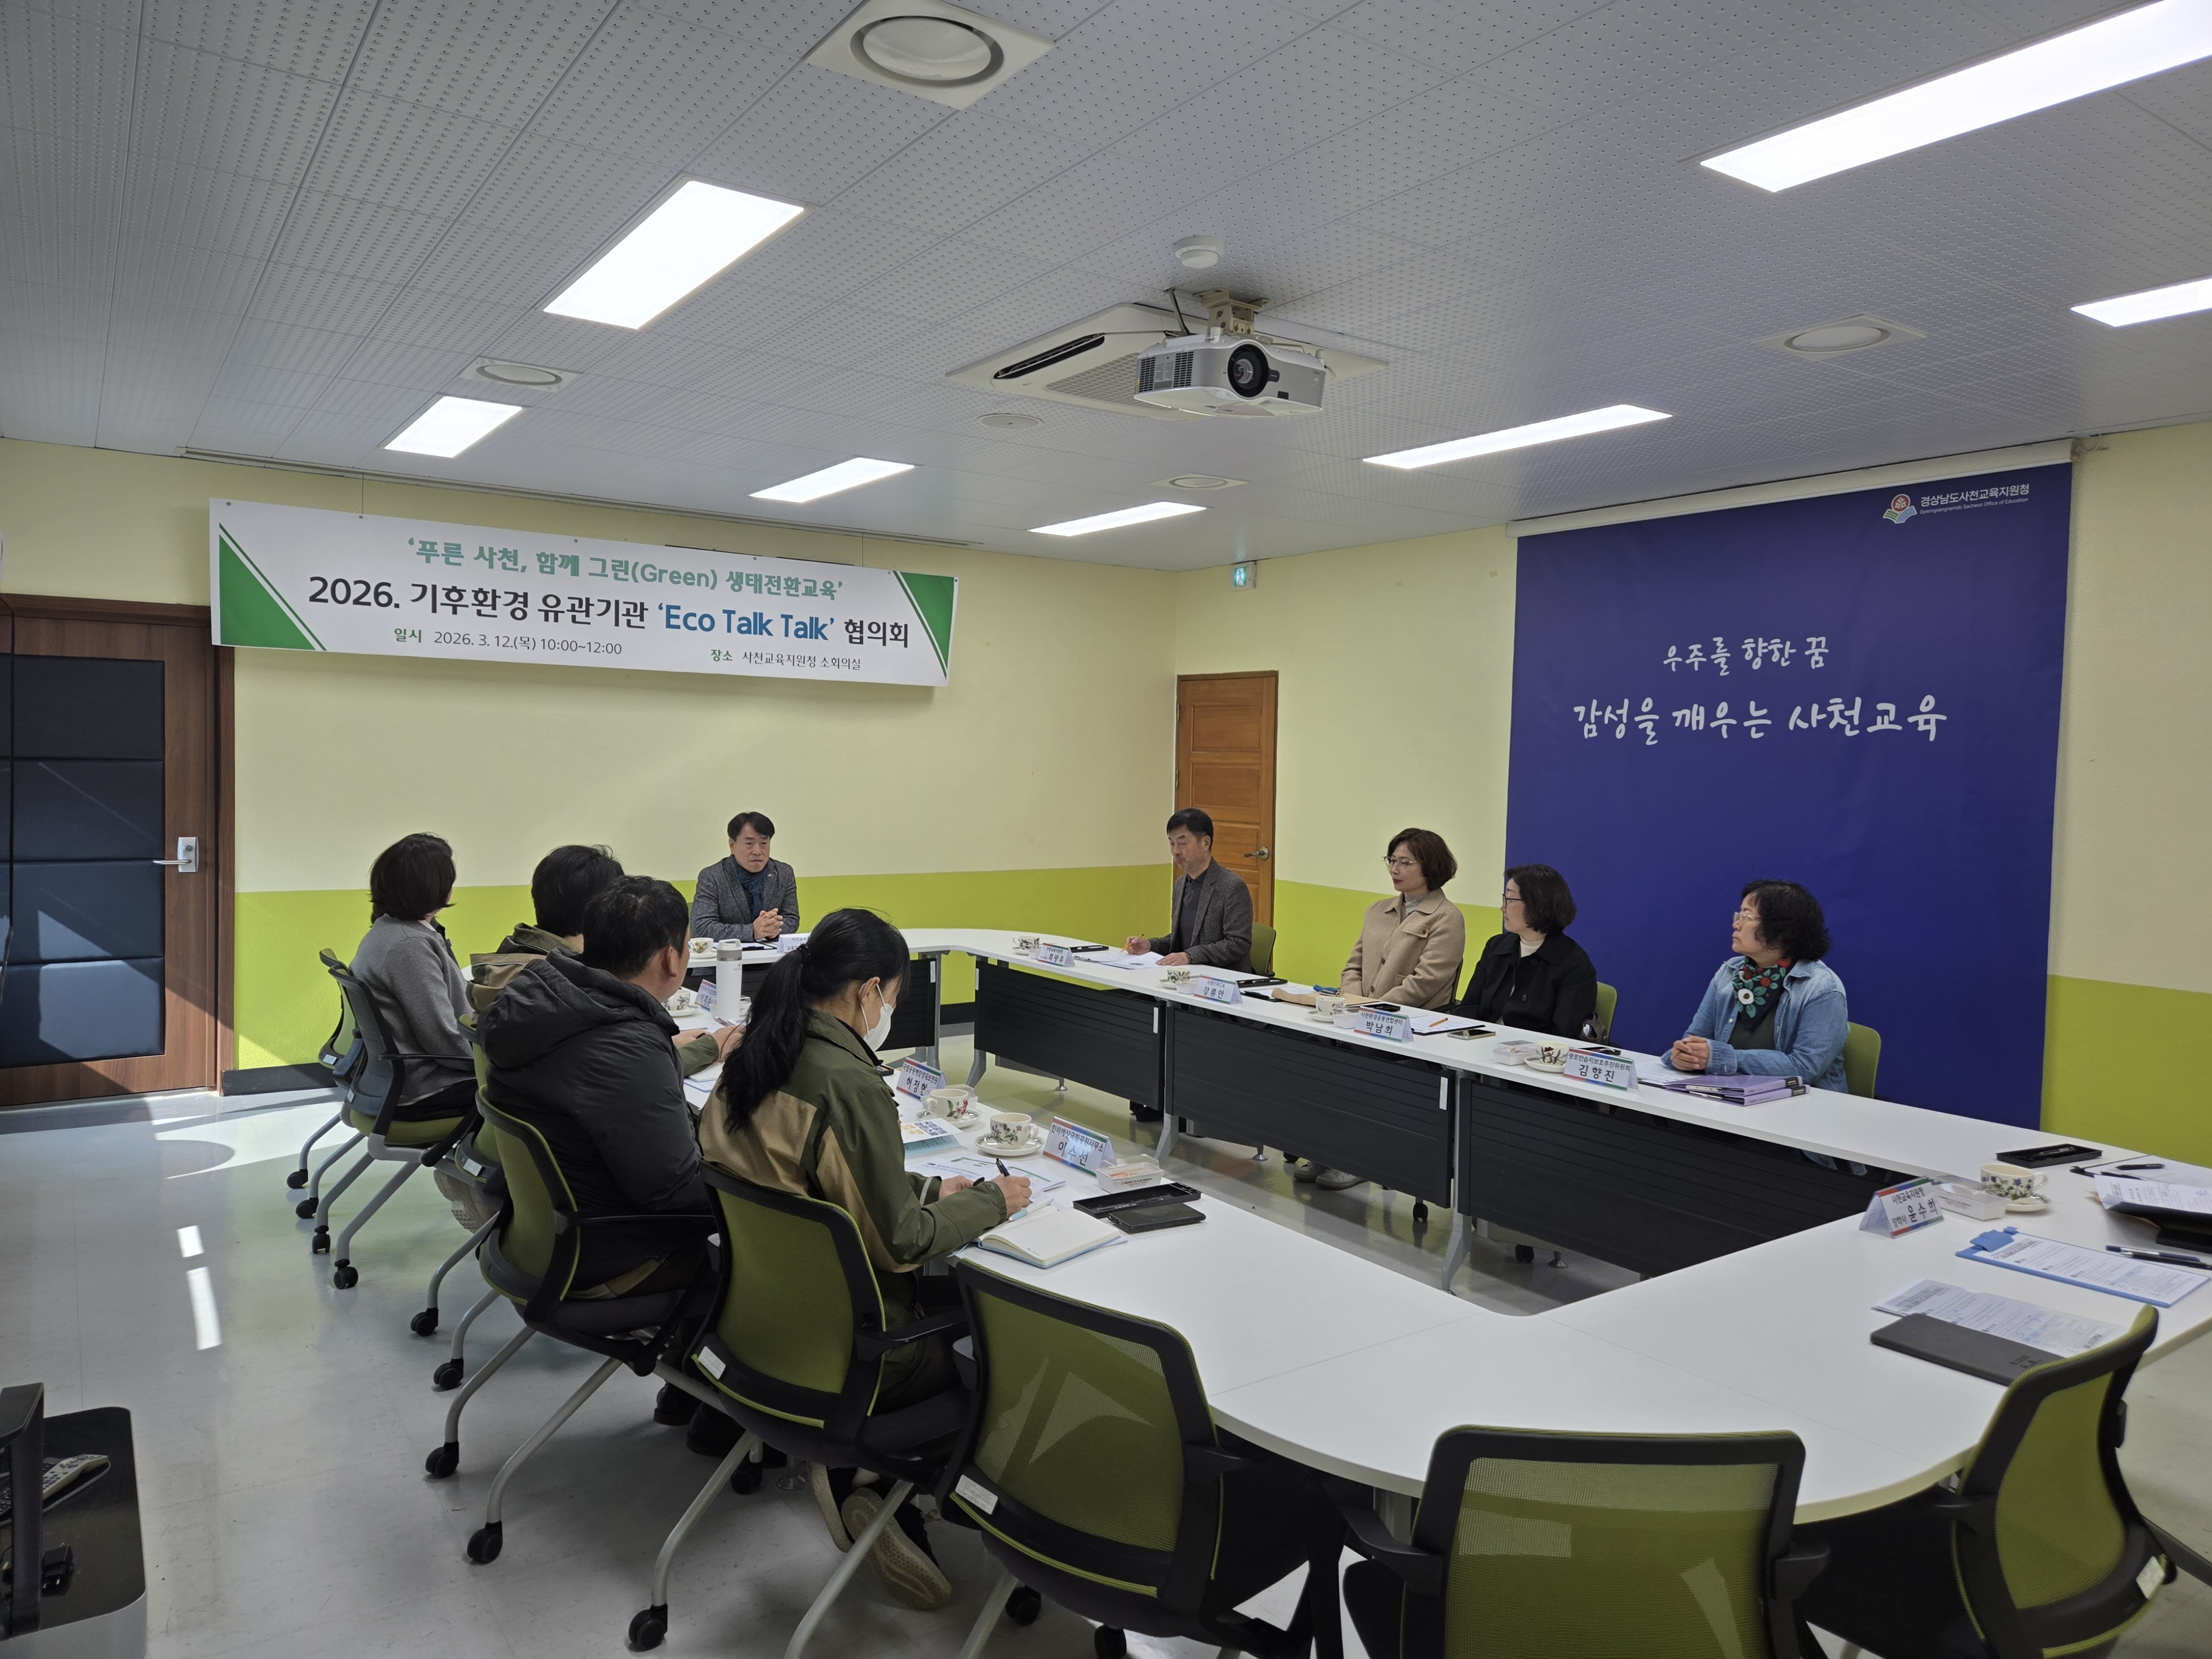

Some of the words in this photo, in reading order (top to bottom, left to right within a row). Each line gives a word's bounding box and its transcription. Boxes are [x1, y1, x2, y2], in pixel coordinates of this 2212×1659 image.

[1921, 484, 2030, 507] 경상남도사천교육지원청
[473, 545, 528, 573] 사천,
[536, 551, 580, 576] 함께
[588, 557, 718, 590] 그린(Green)
[309, 576, 400, 609] 2026.
[410, 583, 529, 621] 기후환경
[538, 594, 649, 629] 유관기관
[722, 609, 774, 637] Talk
[844, 619, 909, 648] 협의회
[394, 628, 422, 644] 일시
[434, 631, 474, 646] 2026.
[478, 634, 490, 647] 3.
[494, 635, 536, 651] 12.(목)
[540, 637, 622, 655] 10:00~12:00
[710, 649, 733, 662] 장소
[742, 650, 816, 668] 사천교육지원청
[820, 656, 862, 671] 소회의실
[1663, 636, 1731, 676] 우주를
[1741, 637, 1797, 670] 향한
[1804, 636, 1829, 669] 꿈
[1573, 697, 1660, 746] 감성을
[1672, 701, 1772, 739] 깨우는
[1788, 695, 1948, 742] 사천교육
[1366, 1021, 1393, 1036] 박남희
[1568, 1053, 1630, 1072] 광포만습지보호추진위원회
[1579, 1065, 1615, 1083] 김향진
[1058, 1141, 1089, 1166] 이수선
[1891, 1186, 1926, 1205] 사천교육지원청
[1892, 1214, 1908, 1228] 장학사
[1908, 1198, 1938, 1223] 윤수희
